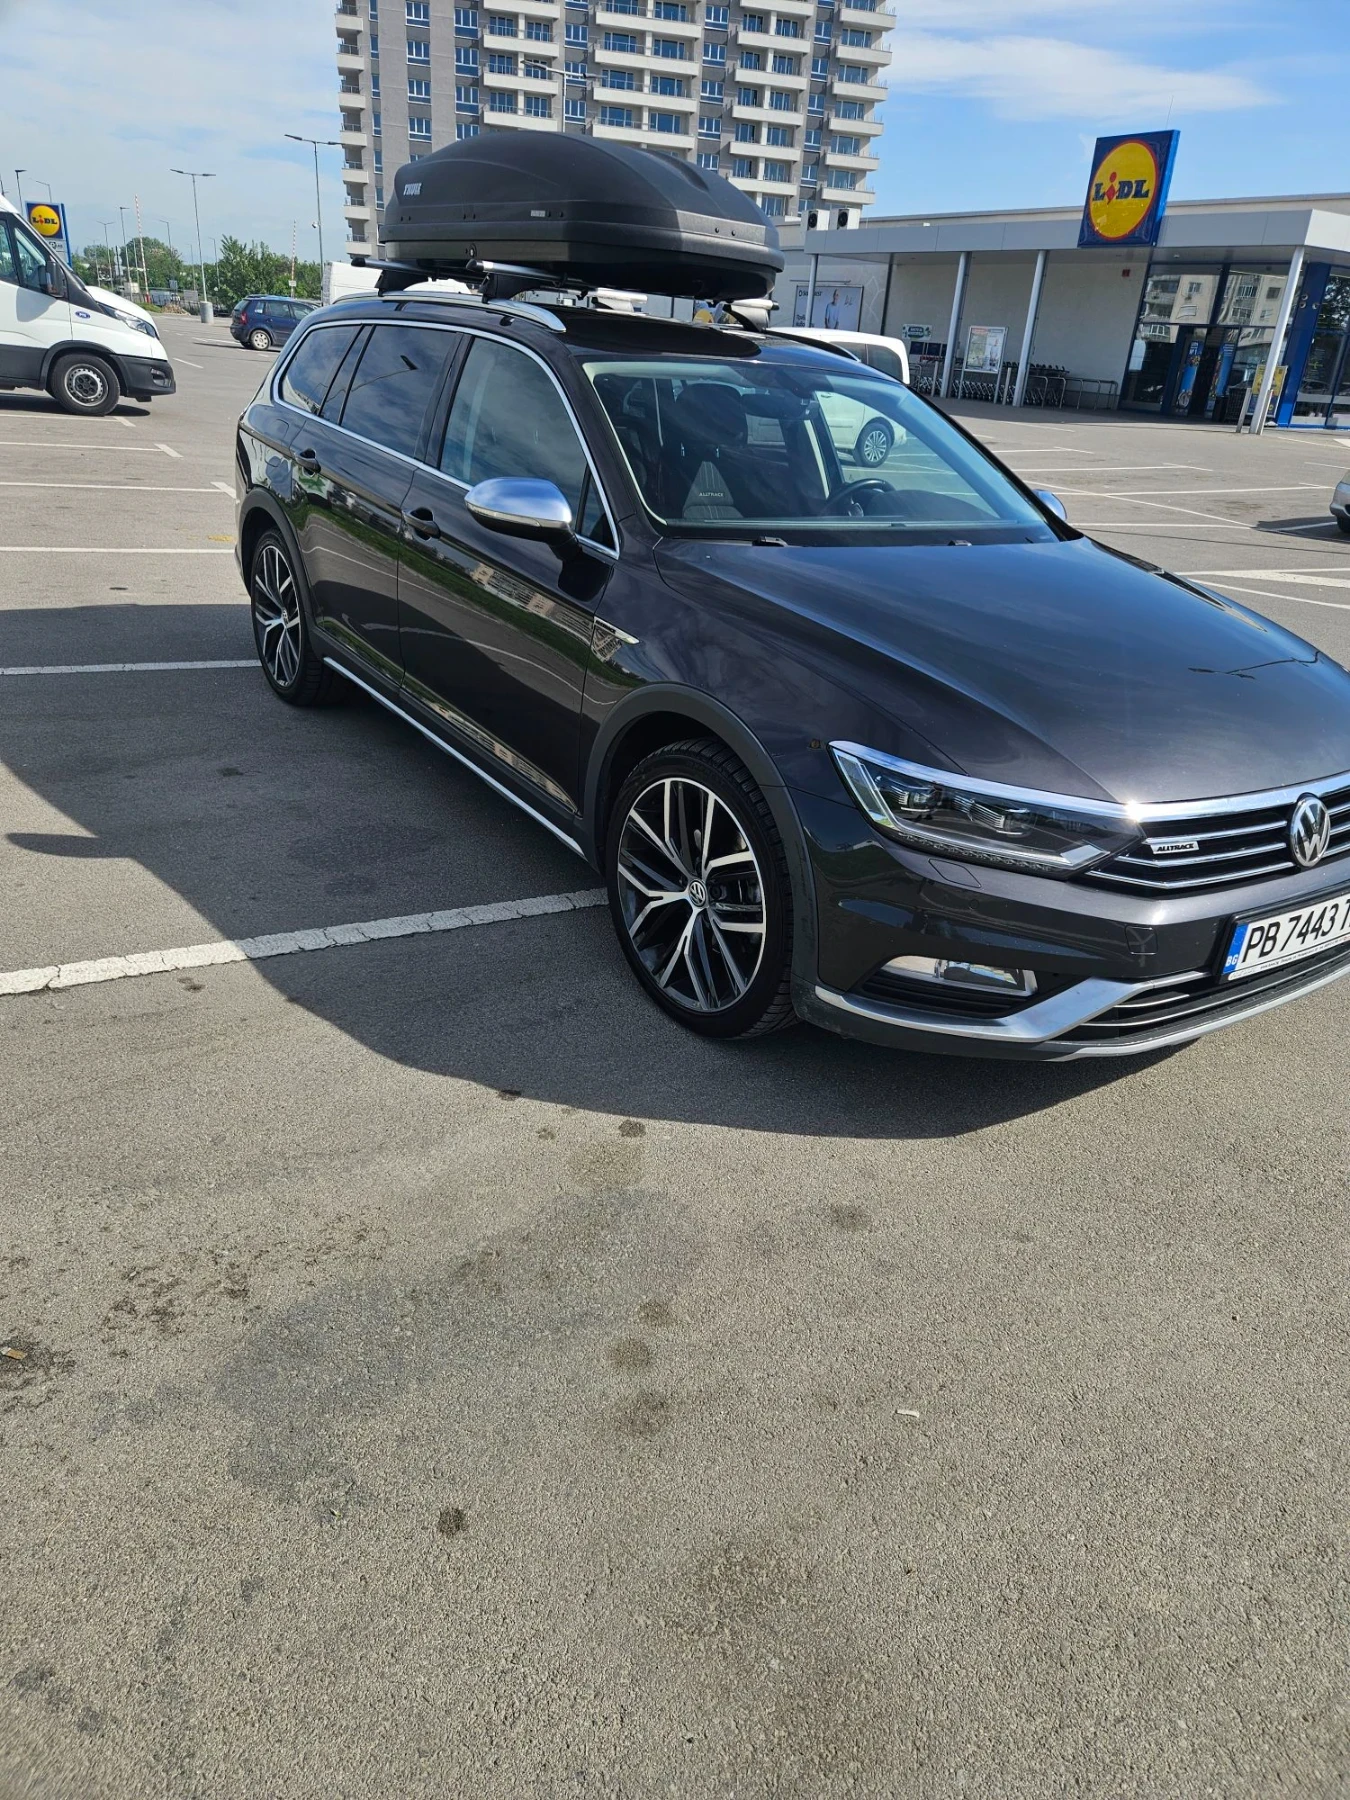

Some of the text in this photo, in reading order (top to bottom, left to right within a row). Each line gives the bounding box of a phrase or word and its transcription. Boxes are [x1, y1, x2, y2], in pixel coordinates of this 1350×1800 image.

[1156, 843, 1195, 852] ALLTRACK
[1241, 921, 1281, 964] PB
[1279, 903, 1340, 952] 7443
[1225, 955, 1239, 967] BG
